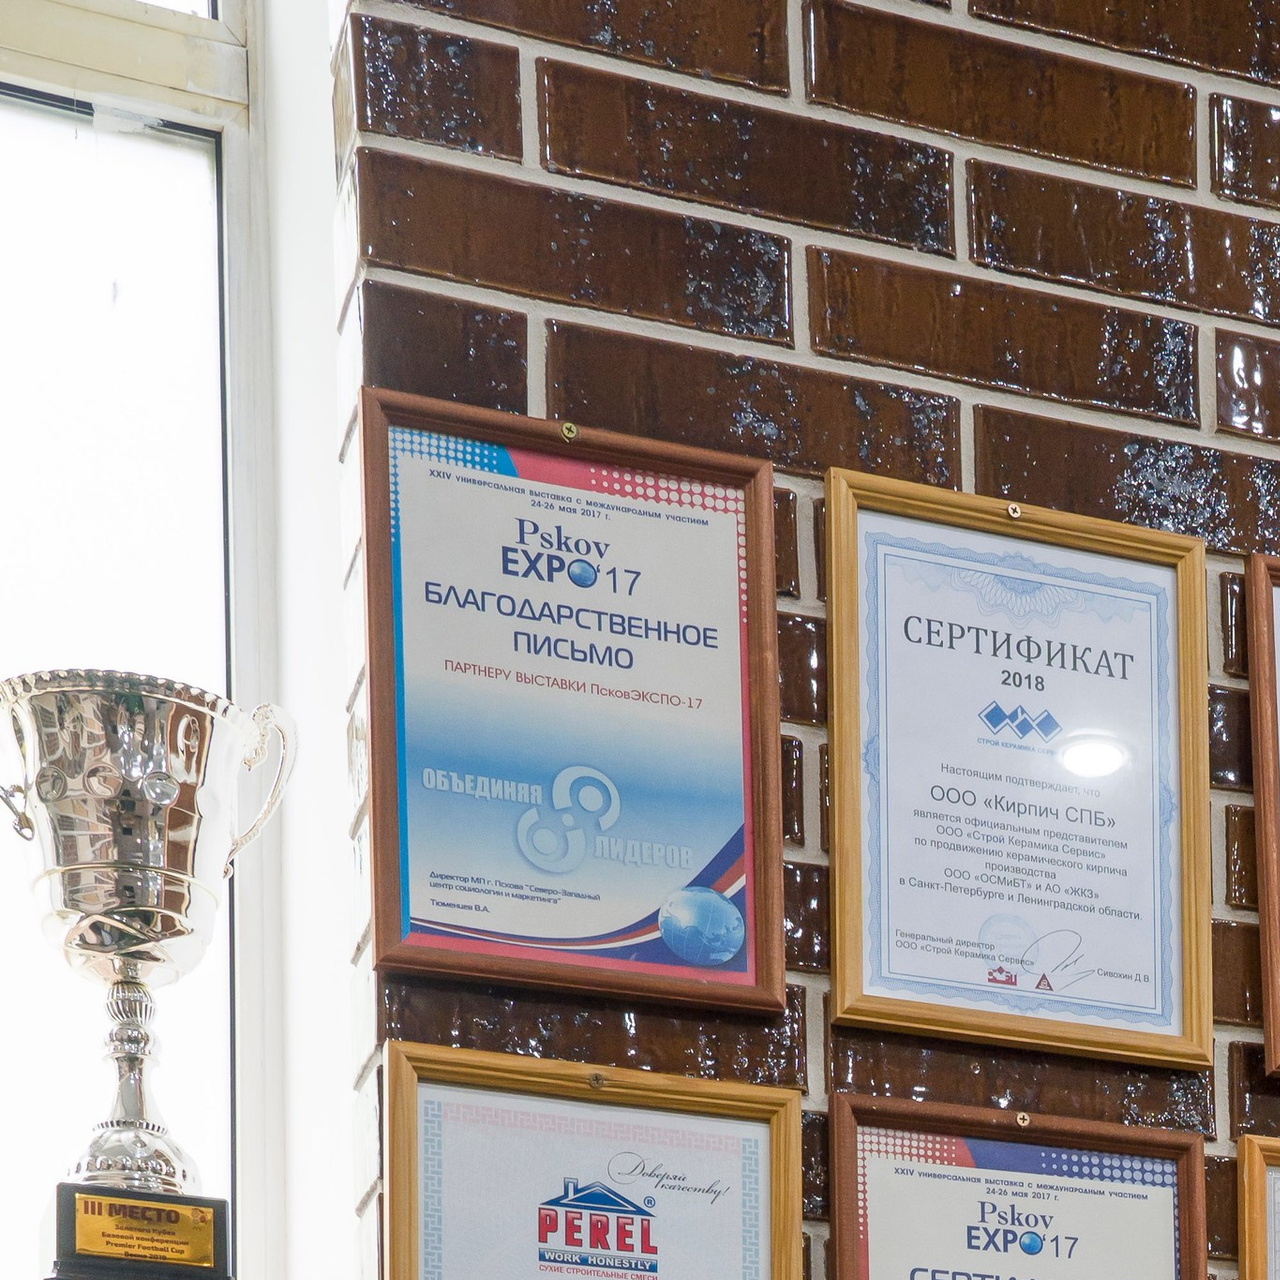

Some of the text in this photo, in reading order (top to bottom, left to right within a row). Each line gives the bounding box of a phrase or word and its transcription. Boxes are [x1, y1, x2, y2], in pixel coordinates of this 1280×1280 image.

[428, 468, 452, 481] XXIV
[456, 475, 525, 495] универсальная
[529, 489, 572, 503] выставка
[586, 500, 661, 519] международным
[664, 513, 709, 526] участием
[530, 498, 555, 511] 24-26
[558, 504, 578, 515] мая
[580, 507, 602, 519] 2017
[515, 517, 610, 559] Pskov
[425, 581, 718, 649] БЛАГОДАРСТВЕННОЕ
[514, 631, 633, 669] ПИСЬМО
[904, 616, 1134, 680] СЕРТИФИКАТ
[444, 659, 702, 709] ПАРТНЕРУ ВЫСТАВКИ ПсковЭКСПО-17
[1001, 670, 1045, 691] 2018
[930, 785, 1116, 828] ООО «Кирпич СПБ»
[944, 867, 971, 880] ООО
[974, 873, 1032, 889] «ОСМиБТ»
[1044, 882, 1062, 894] АО
[1064, 886, 1099, 899] «ЖКЗ»
[608, 1152, 686, 1188] Доверяй
[660, 1179, 730, 1204] качеству!
[84, 1200, 180, 1225] III МЕСТО
[978, 1201, 1054, 1229] Pskov
[106, 1241, 185, 1255] Premier Football Cup
[538, 1207, 658, 1255] PEREL
[538, 1263, 565, 1274] СУХИЕ
[566, 1267, 628, 1280] СТРОИТЕЛЬНЫЕ
[544, 1252, 652, 1270] WORK HONESTLY
